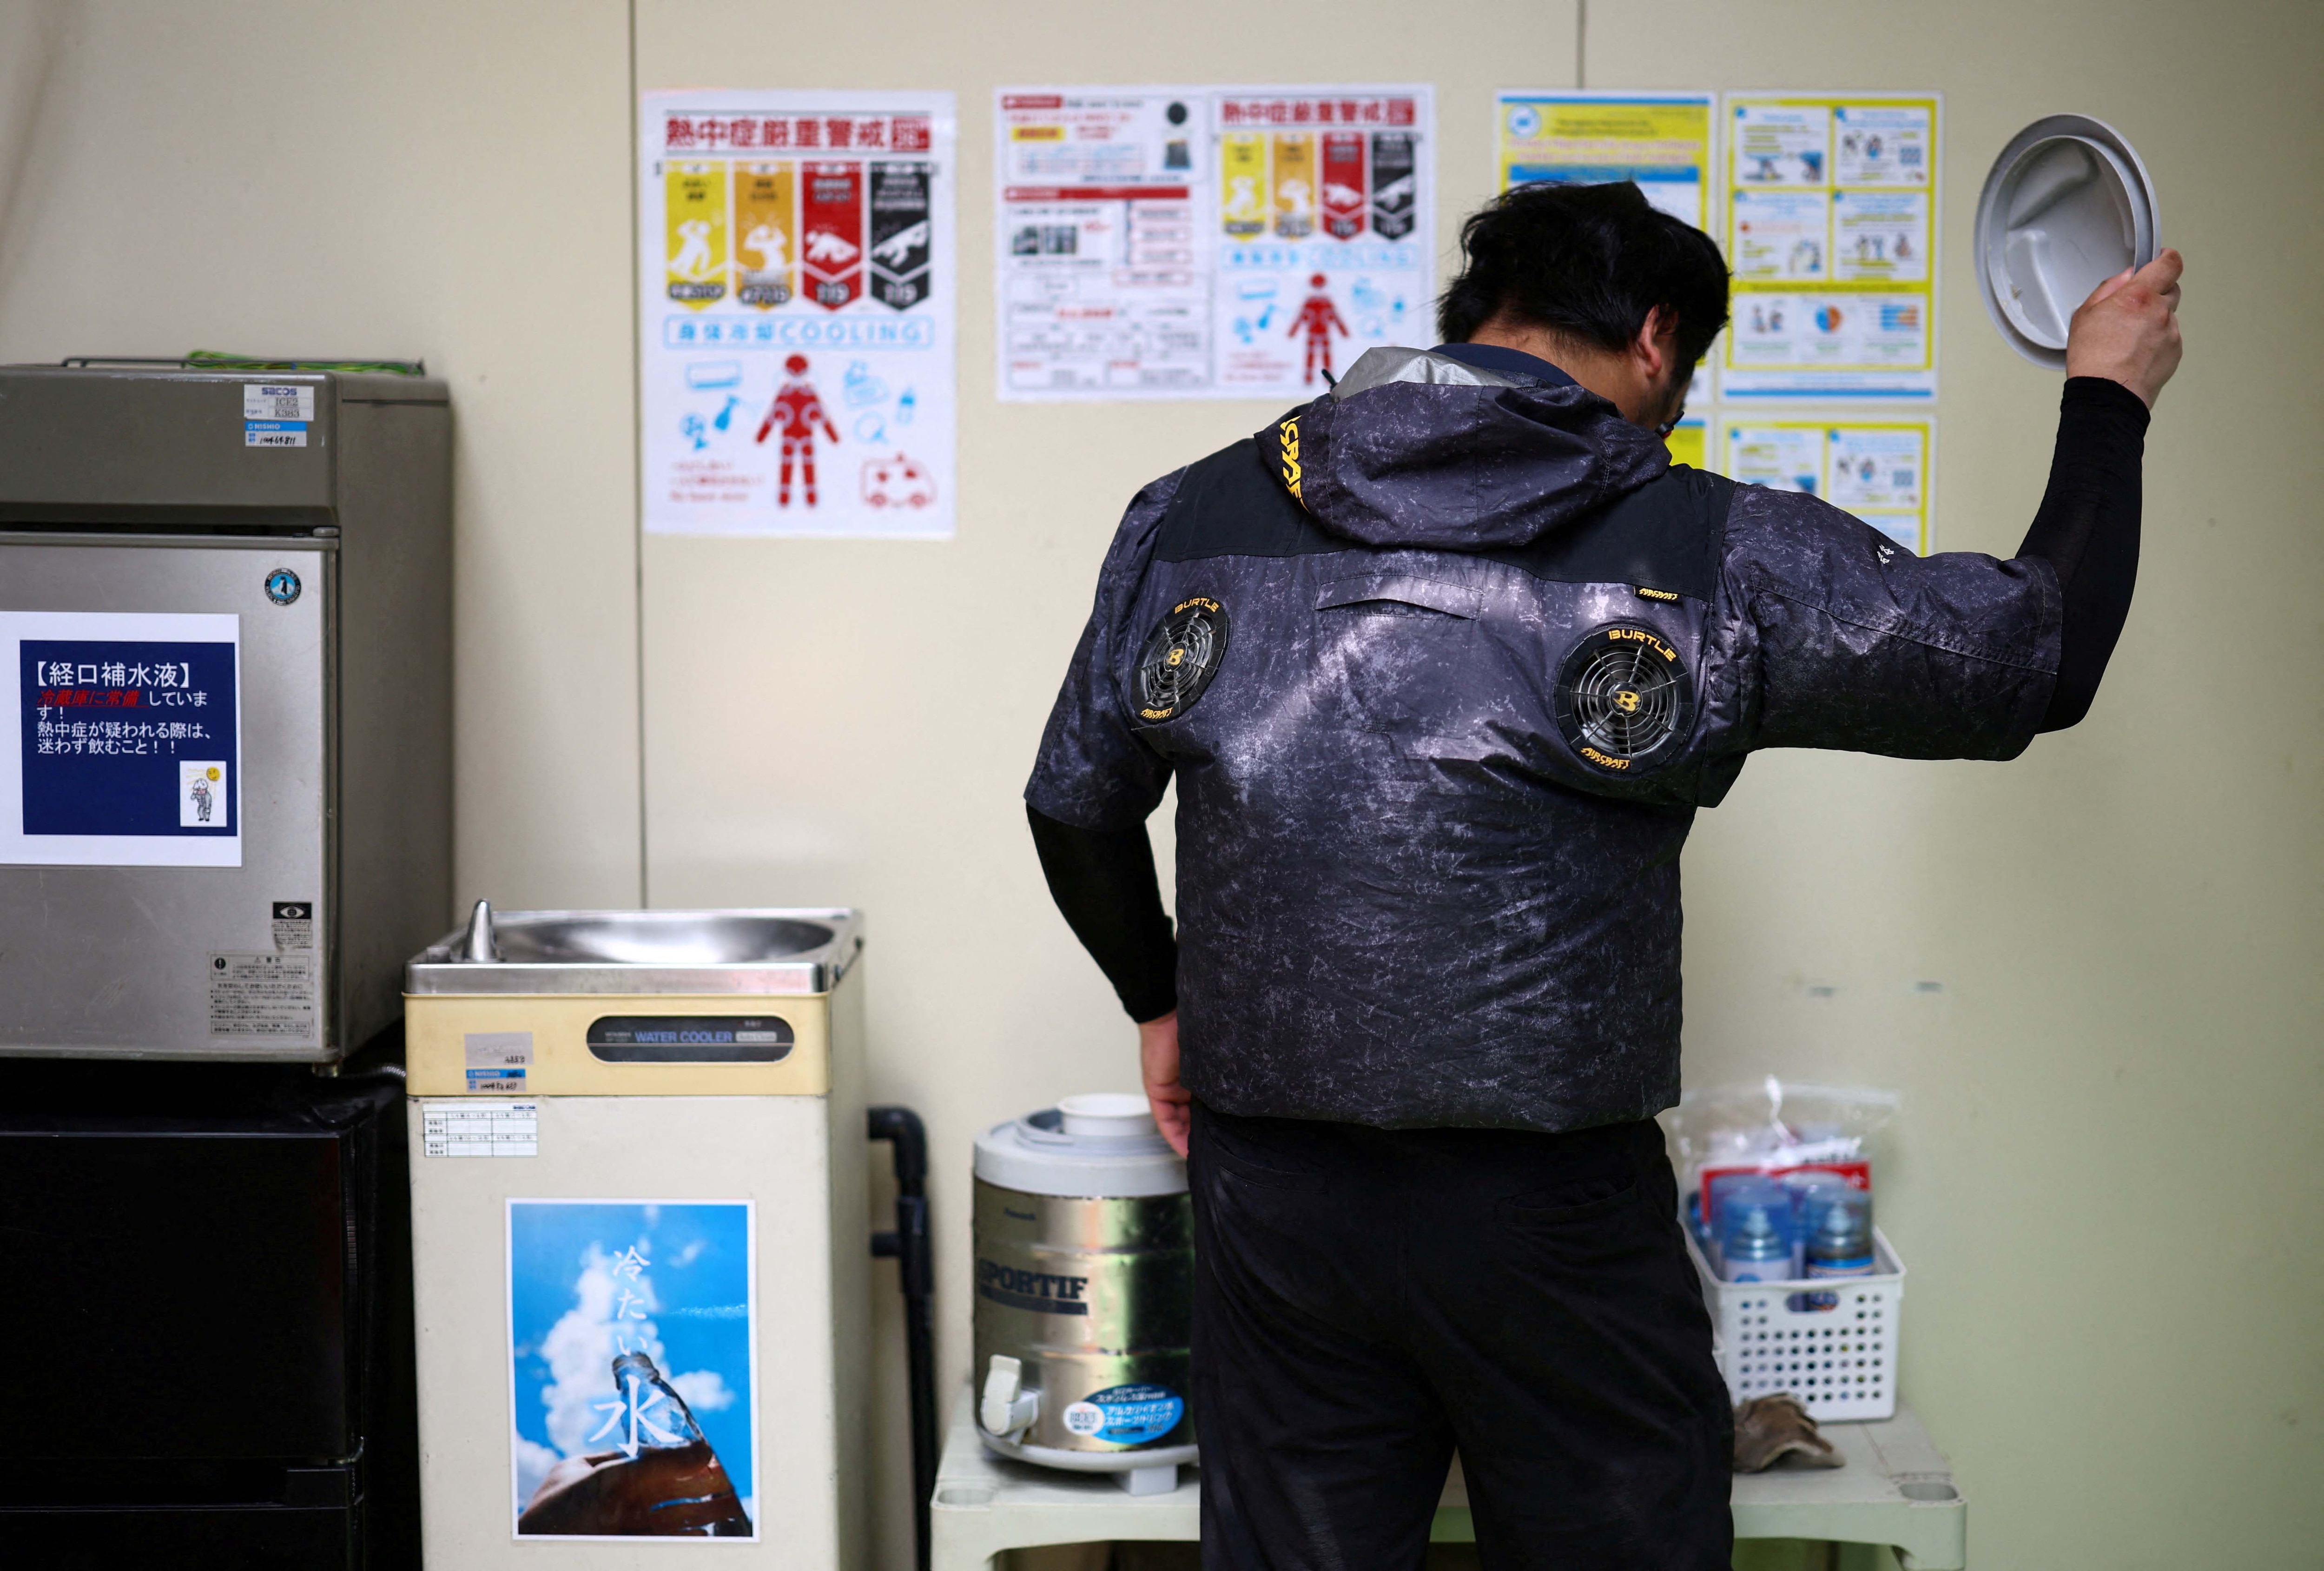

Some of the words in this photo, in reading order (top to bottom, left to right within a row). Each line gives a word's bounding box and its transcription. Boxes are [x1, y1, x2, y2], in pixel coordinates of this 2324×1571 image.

[1639, 588, 1678, 600] AIRCRAFT
[1175, 597, 1219, 614] BURTLE
[1608, 629, 1676, 662] BURTLE
[37, 661, 190, 689] 【経口補水液】
[37, 689, 141, 707] 冷蔵庫に常備
[149, 691, 208, 707] していま
[37, 722, 211, 739] 熱中症が疑われる際は、
[37, 738, 175, 755] 迷わず飲むこと！！
[1581, 747, 1630, 769] AIRCRAFT
[634, 1030, 677, 1043] WATER
[680, 1030, 733, 1043] COOLER
[612, 1244, 650, 1356] 冷たい
[588, 1374, 684, 1459] 水
